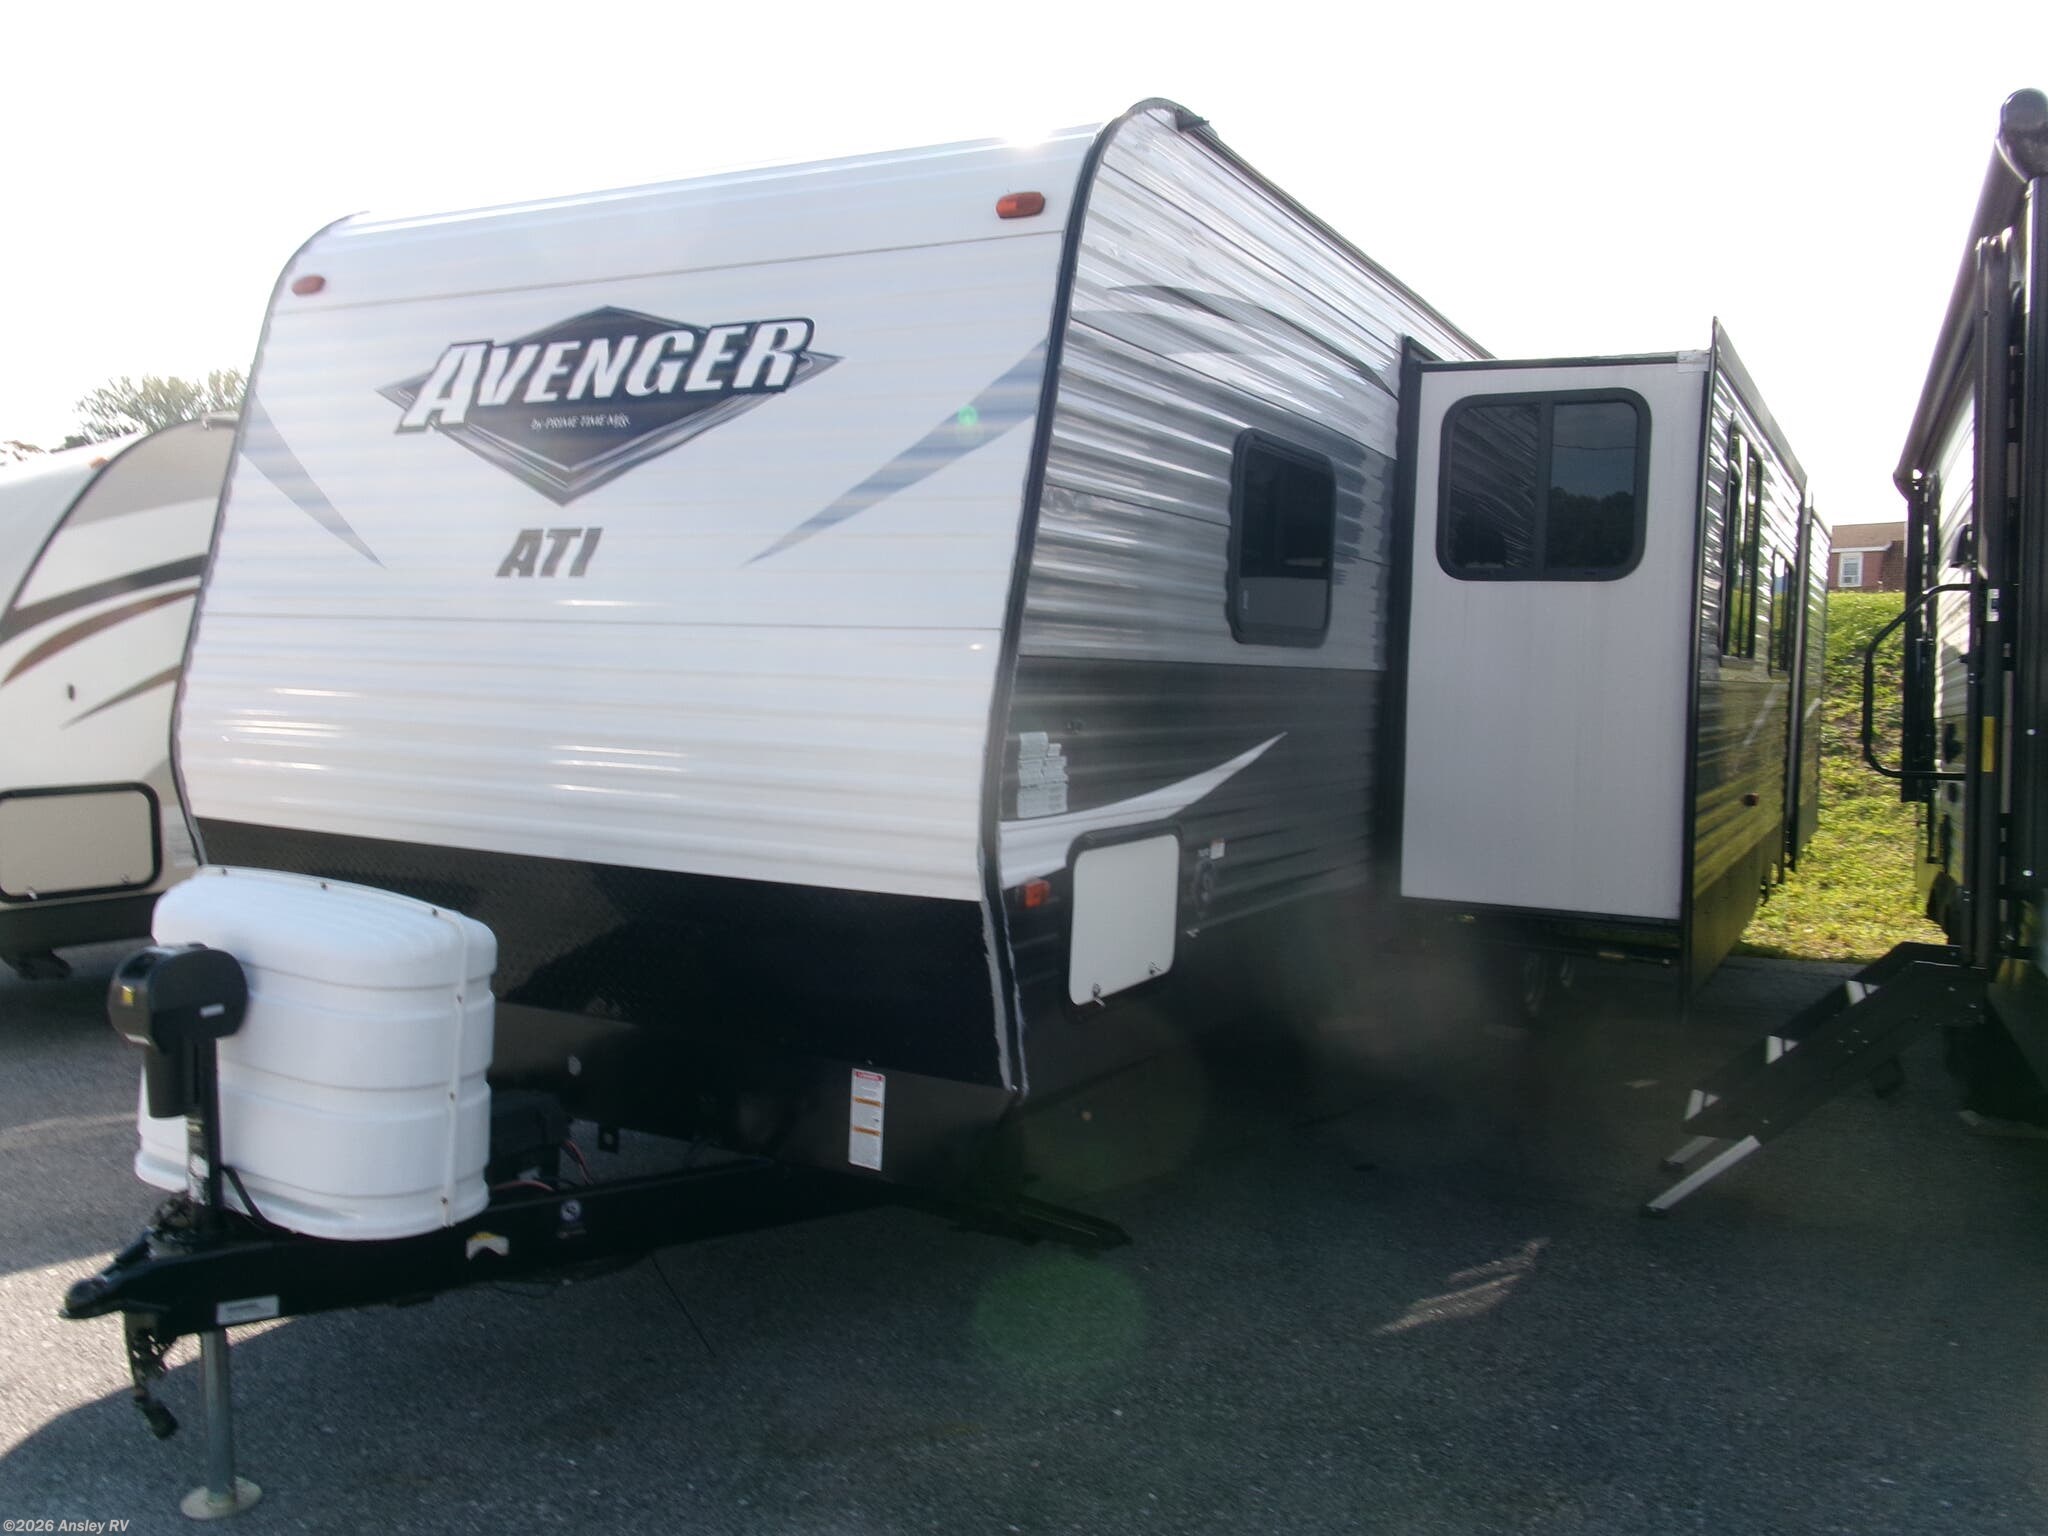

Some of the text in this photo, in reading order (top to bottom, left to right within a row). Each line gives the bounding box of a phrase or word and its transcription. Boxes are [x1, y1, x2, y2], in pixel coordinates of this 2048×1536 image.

[396, 318, 815, 432] AVENGER
[544, 415, 579, 429] PRIME
[580, 413, 606, 427] TIME
[496, 527, 603, 577] ATI
